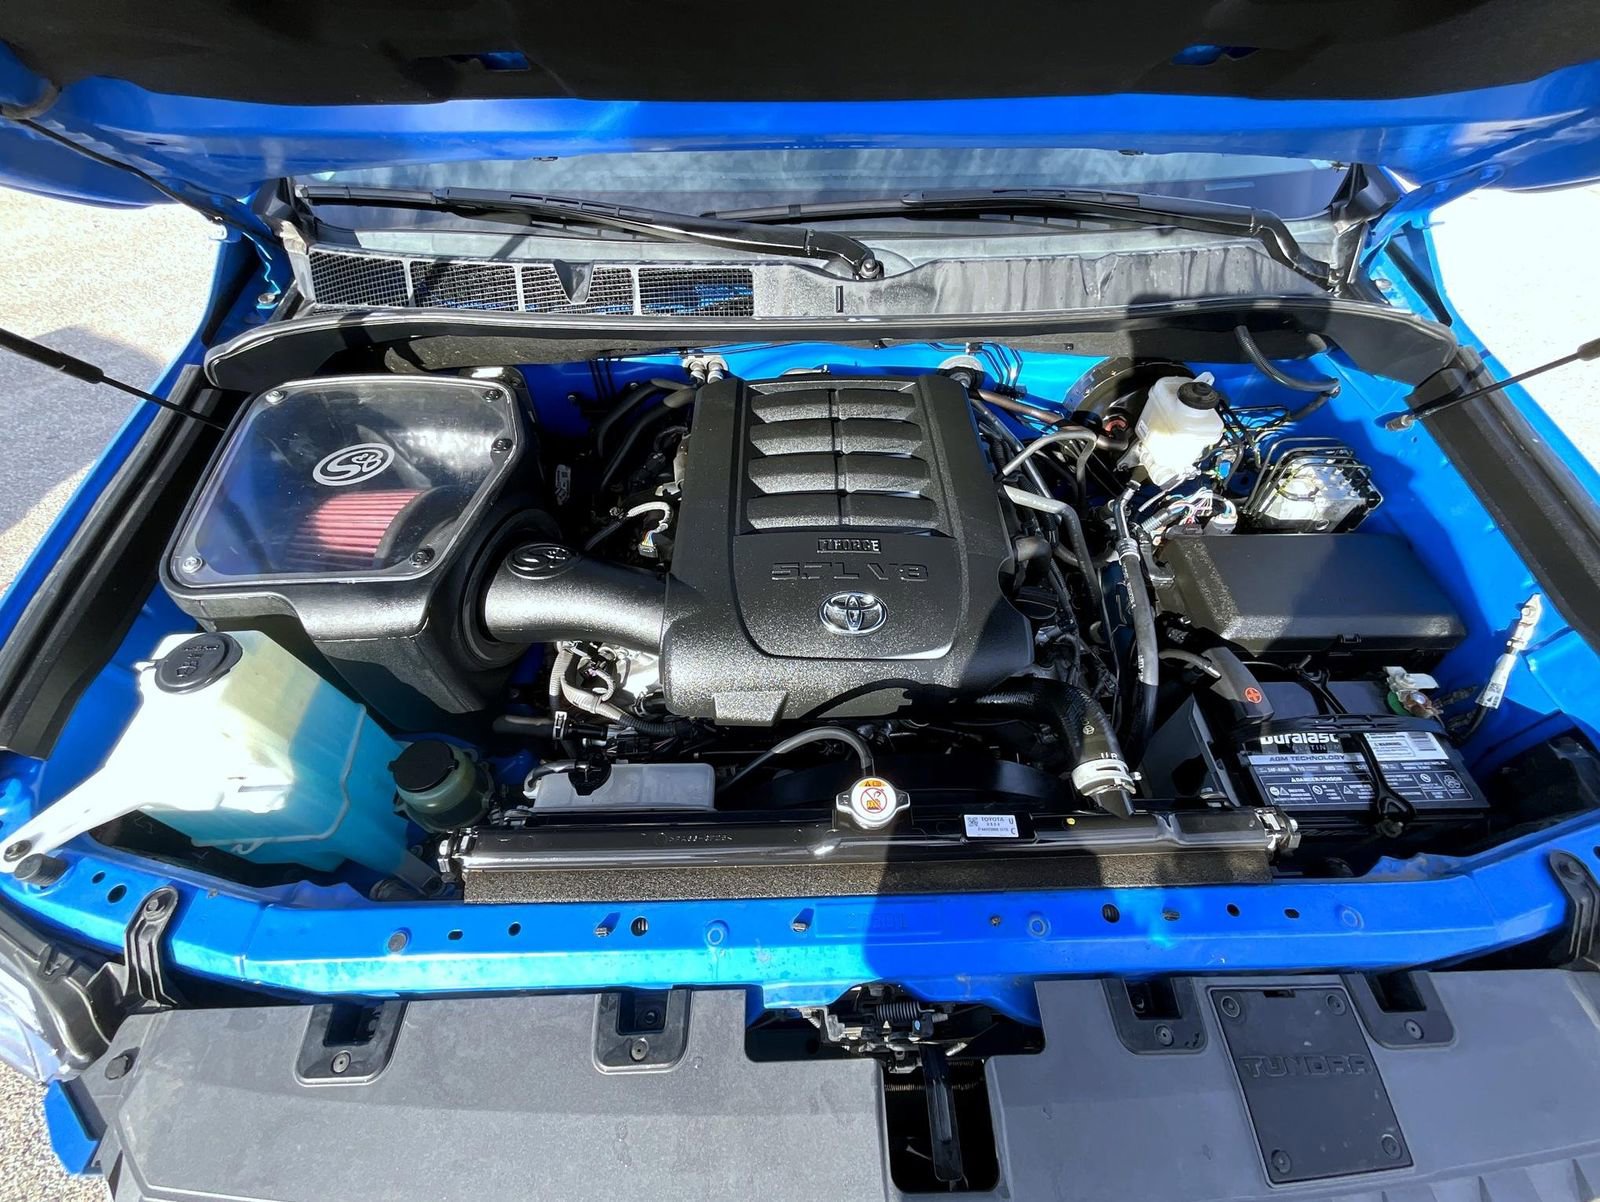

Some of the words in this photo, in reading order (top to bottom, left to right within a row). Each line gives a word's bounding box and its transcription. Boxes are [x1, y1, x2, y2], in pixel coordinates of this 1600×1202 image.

[319, 448, 385, 481] S&B
[866, 562, 929, 582] V8
[1259, 732, 1339, 745] Duralast
[1238, 1053, 1373, 1078] TUNDRA
